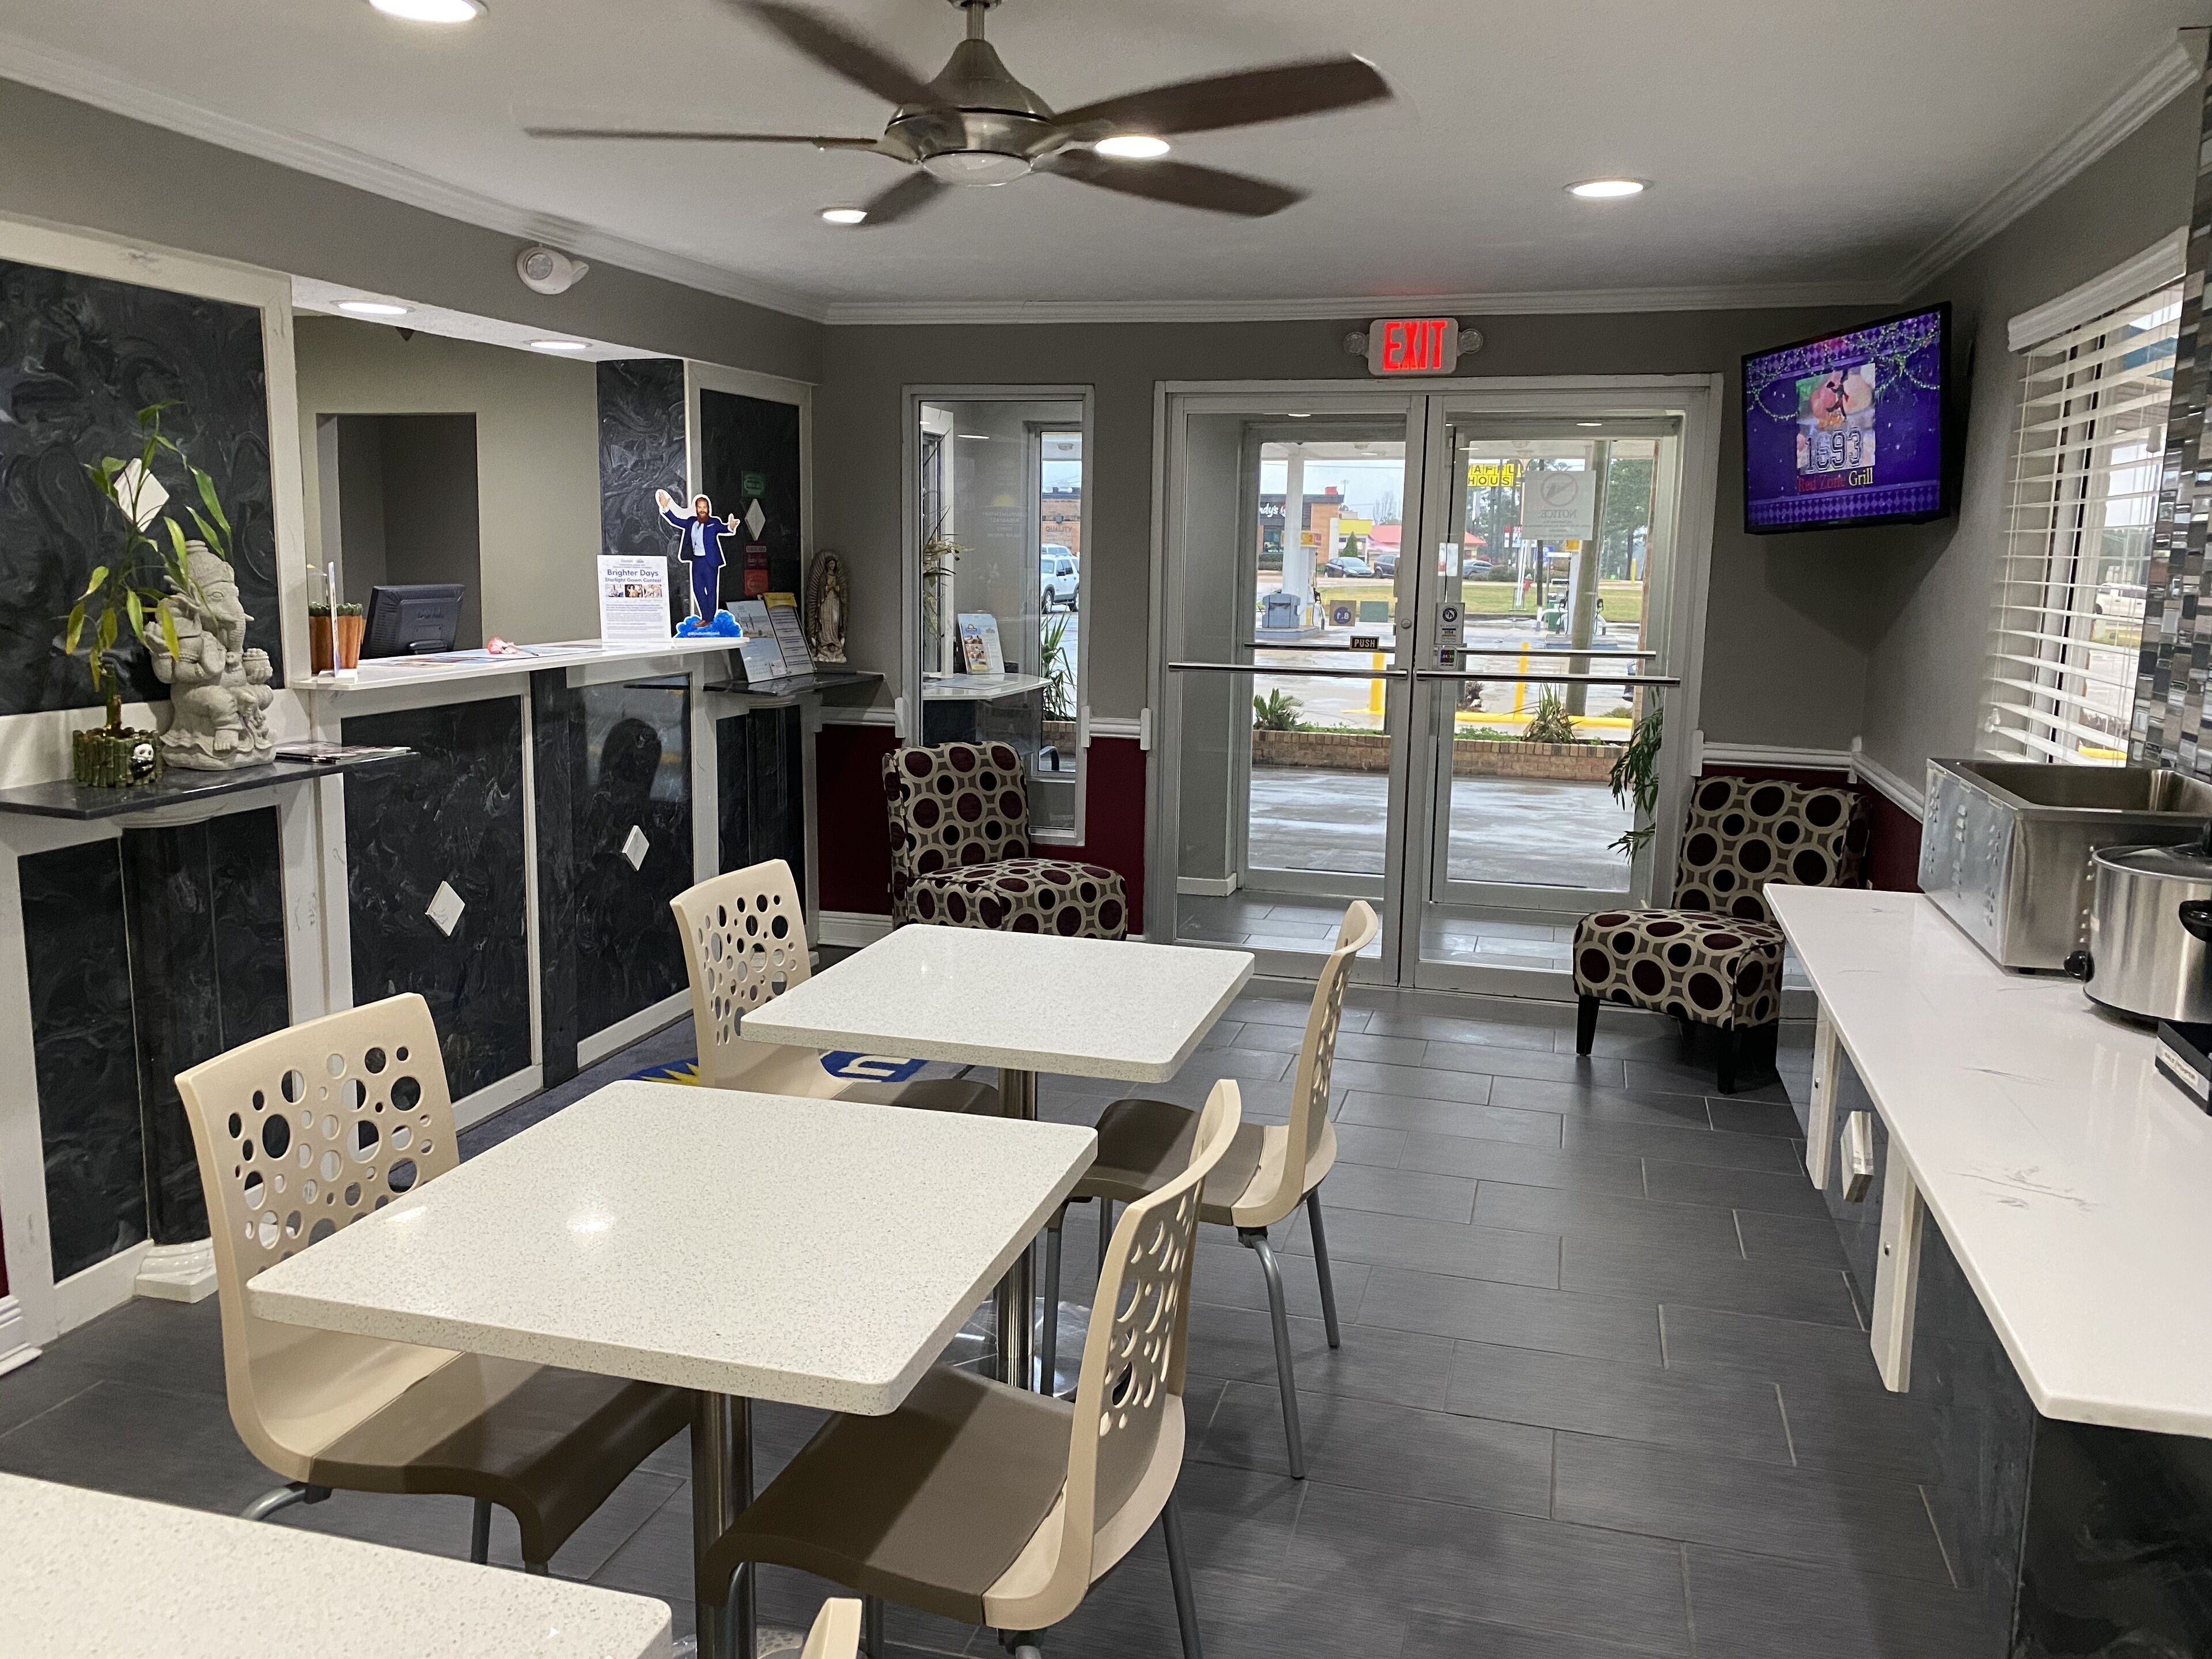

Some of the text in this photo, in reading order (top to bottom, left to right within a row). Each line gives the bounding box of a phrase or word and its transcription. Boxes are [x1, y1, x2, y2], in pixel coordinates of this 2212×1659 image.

[1383, 320, 1448, 370] EXIT
[1468, 476, 1517, 485] HOUS
[1798, 475, 1816, 492] Red
[1849, 467, 1873, 486] Grill
[607, 569, 659, 578] Brighter Days
[1354, 639, 1376, 647] PUSH
